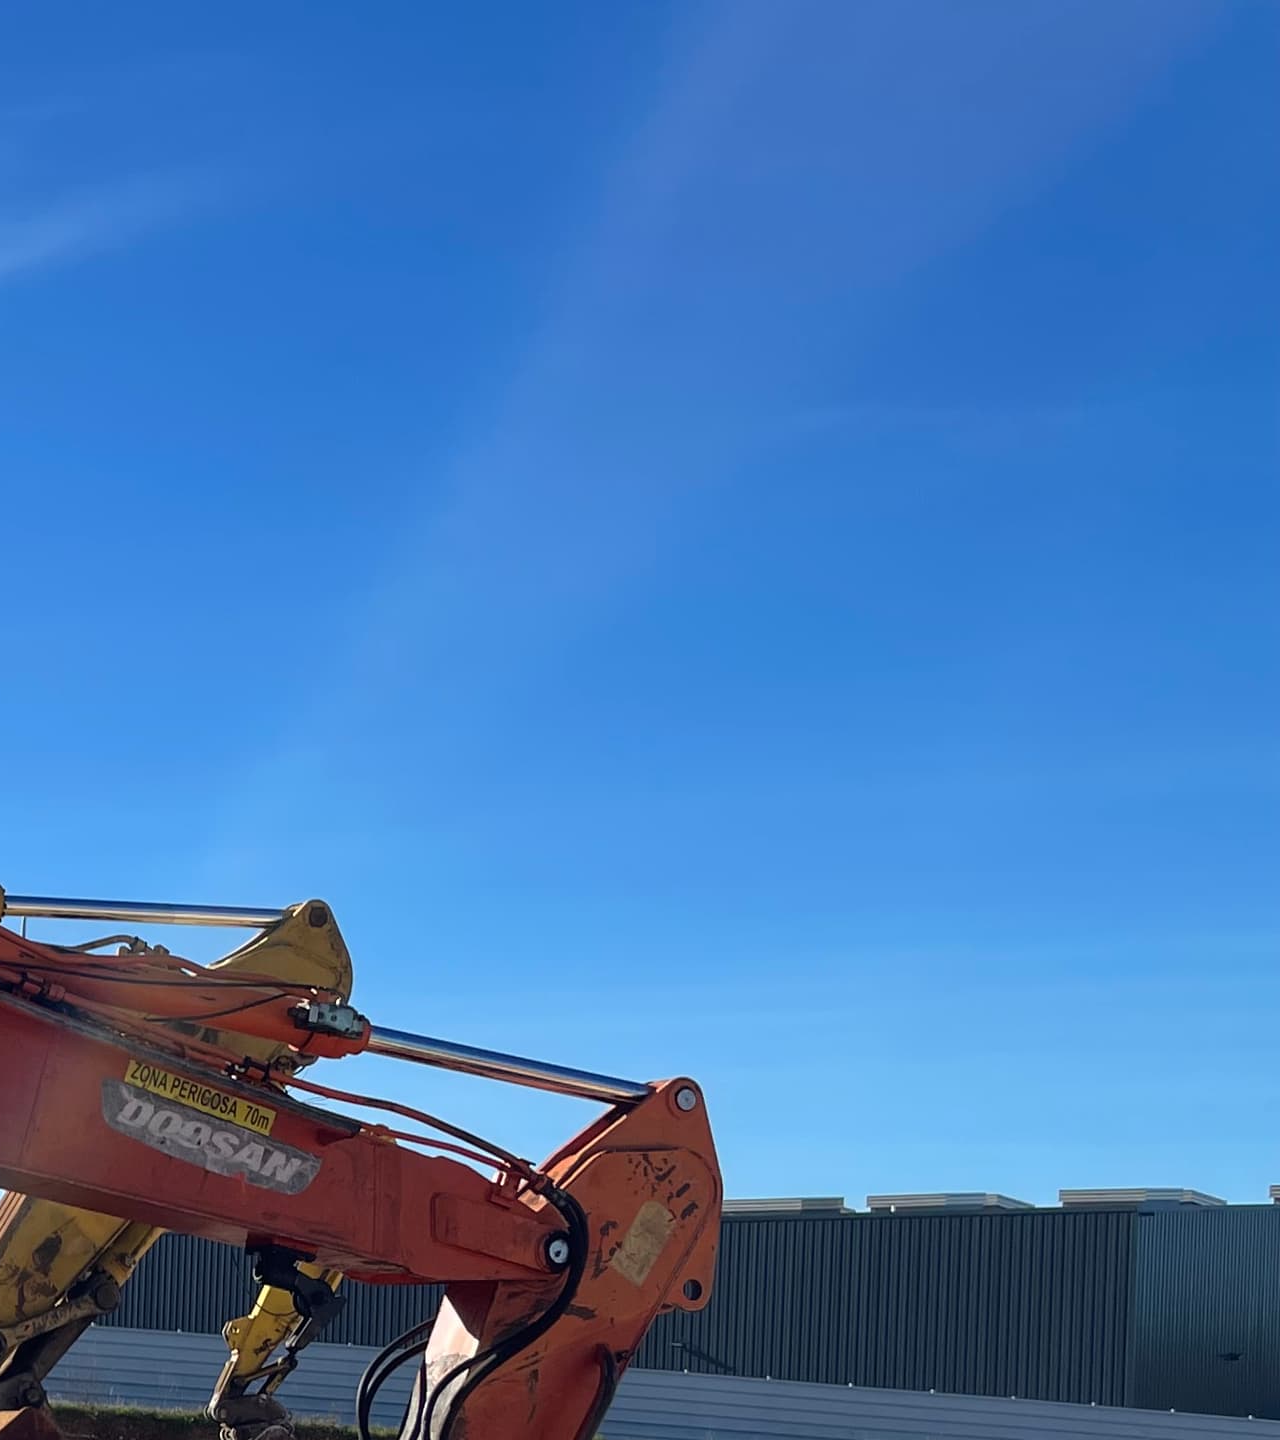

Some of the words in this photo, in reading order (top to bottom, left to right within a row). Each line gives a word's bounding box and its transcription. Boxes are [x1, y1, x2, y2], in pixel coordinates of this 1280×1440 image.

[130, 1062, 168, 1092] ZONA
[170, 1079, 237, 1118] PERIGOSA
[244, 1104, 270, 1130] 70m
[116, 1095, 302, 1183] DOOSAN
